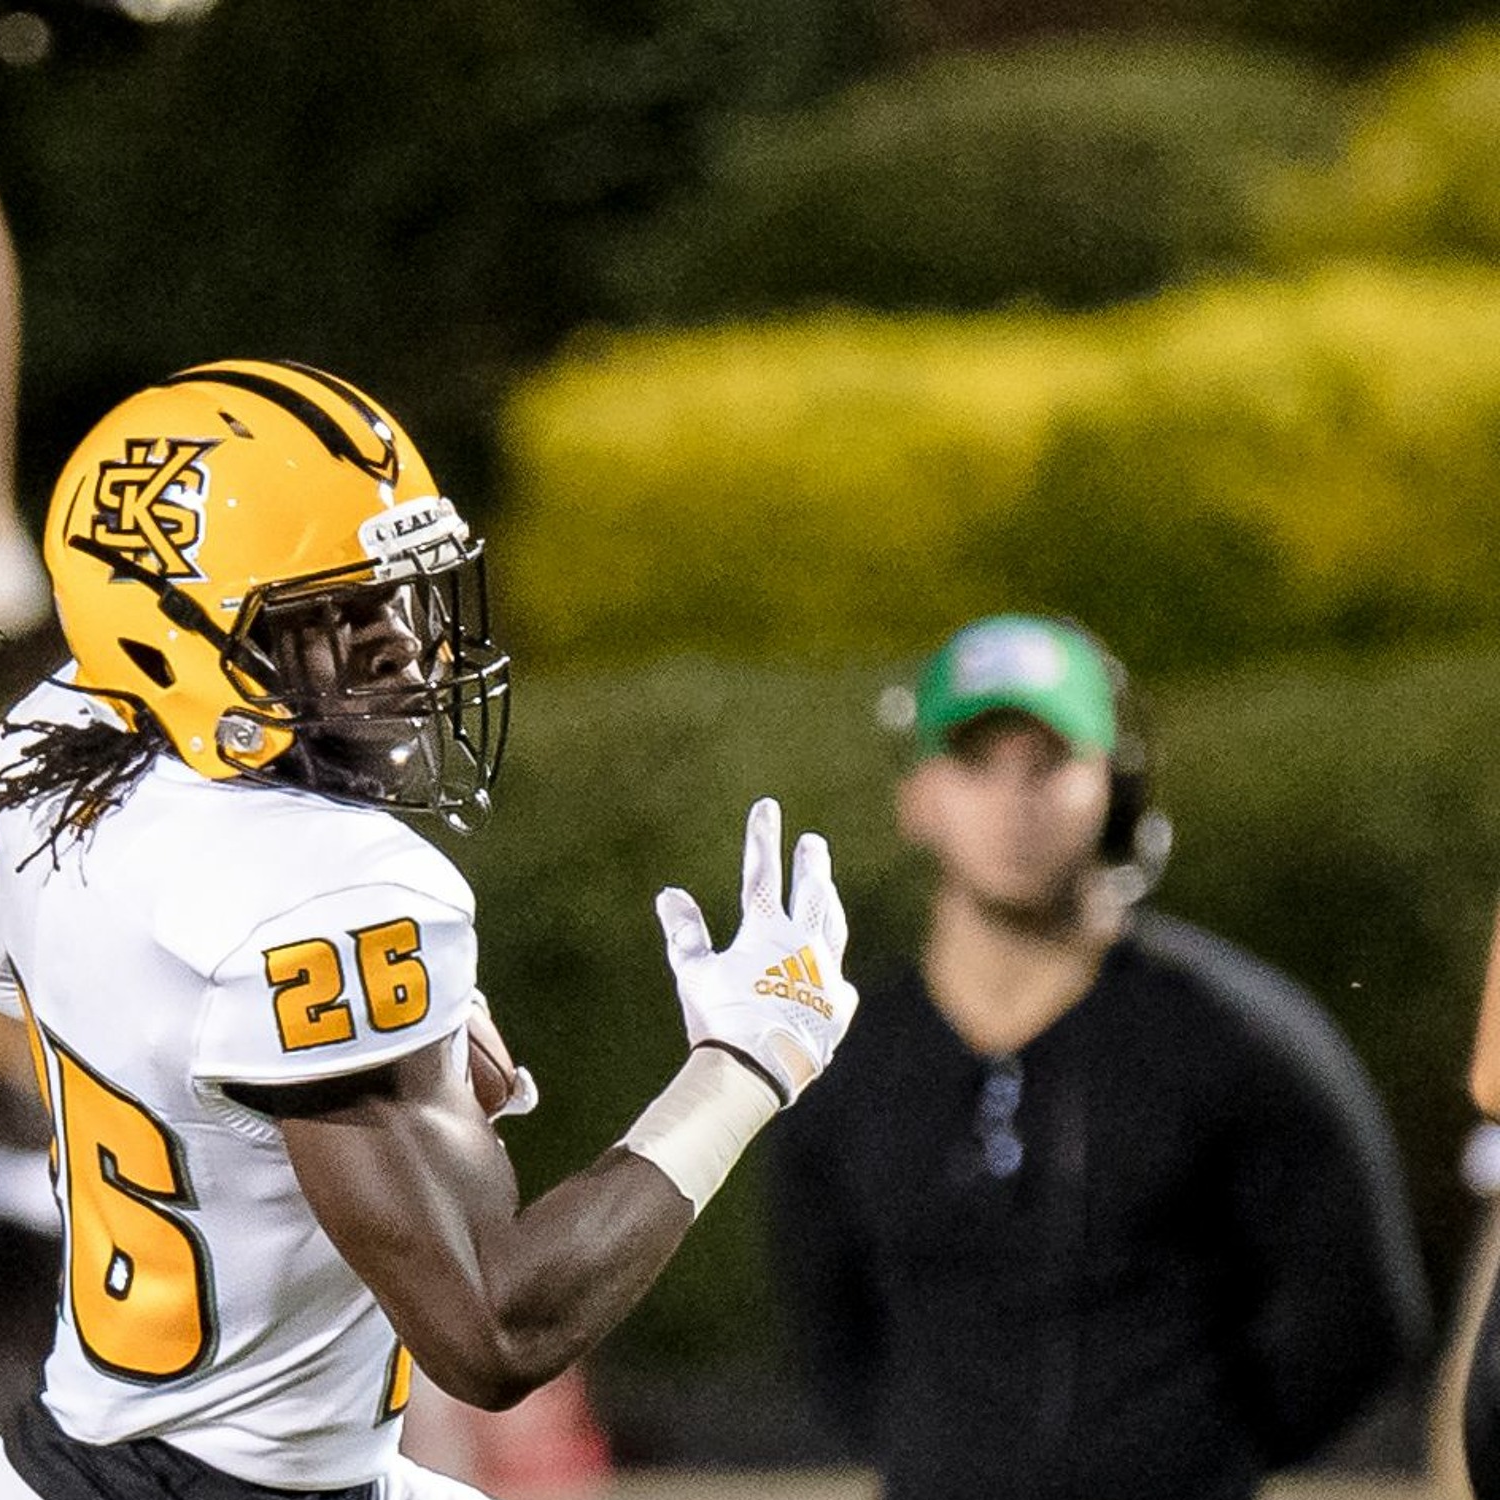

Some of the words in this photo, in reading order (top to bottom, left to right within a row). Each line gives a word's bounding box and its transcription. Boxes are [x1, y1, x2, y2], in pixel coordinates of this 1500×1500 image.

[261, 916, 431, 1053] 26
[753, 978, 834, 1021] adidas
[6, 955, 219, 1387] 6
